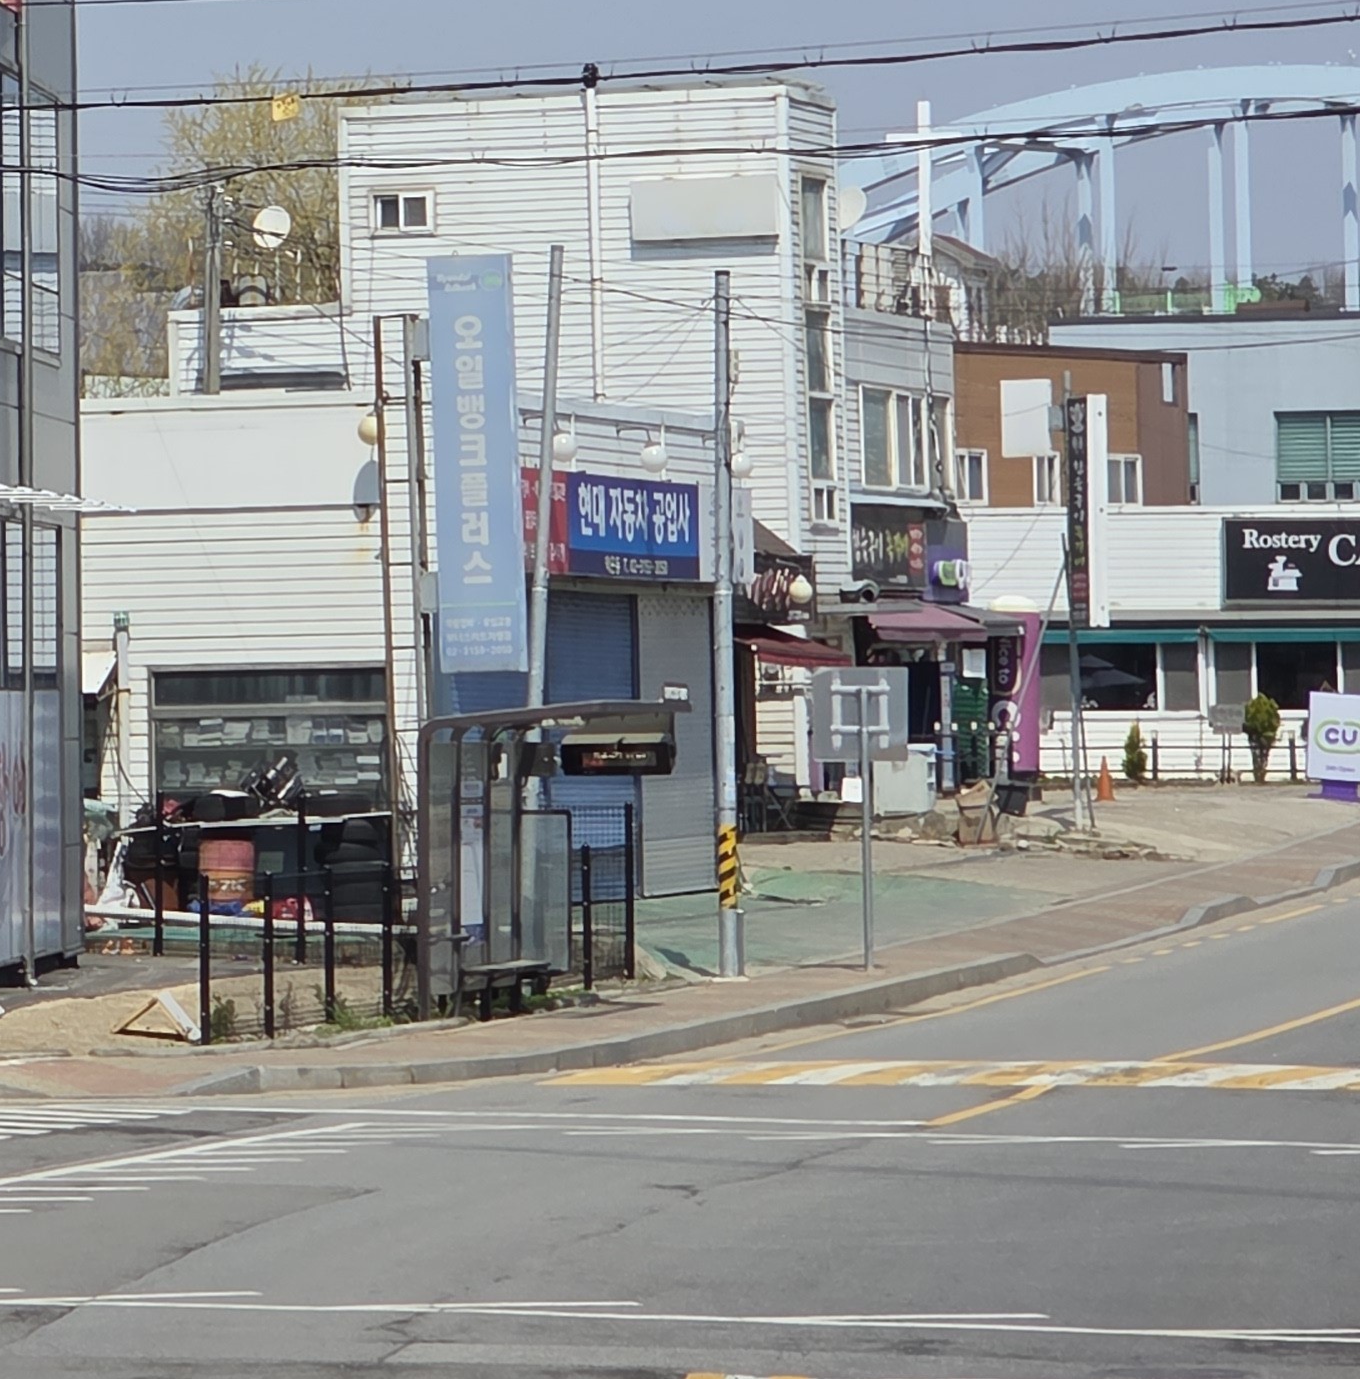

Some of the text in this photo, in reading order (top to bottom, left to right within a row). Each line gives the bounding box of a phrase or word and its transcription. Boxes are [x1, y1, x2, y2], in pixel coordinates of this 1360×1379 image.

[578, 481, 606, 538] 현대
[609, 487, 650, 543] 자동차
[652, 491, 691, 545] 공업사
[1241, 528, 1360, 567] Rostery C
[1324, 727, 1358, 746] CU
